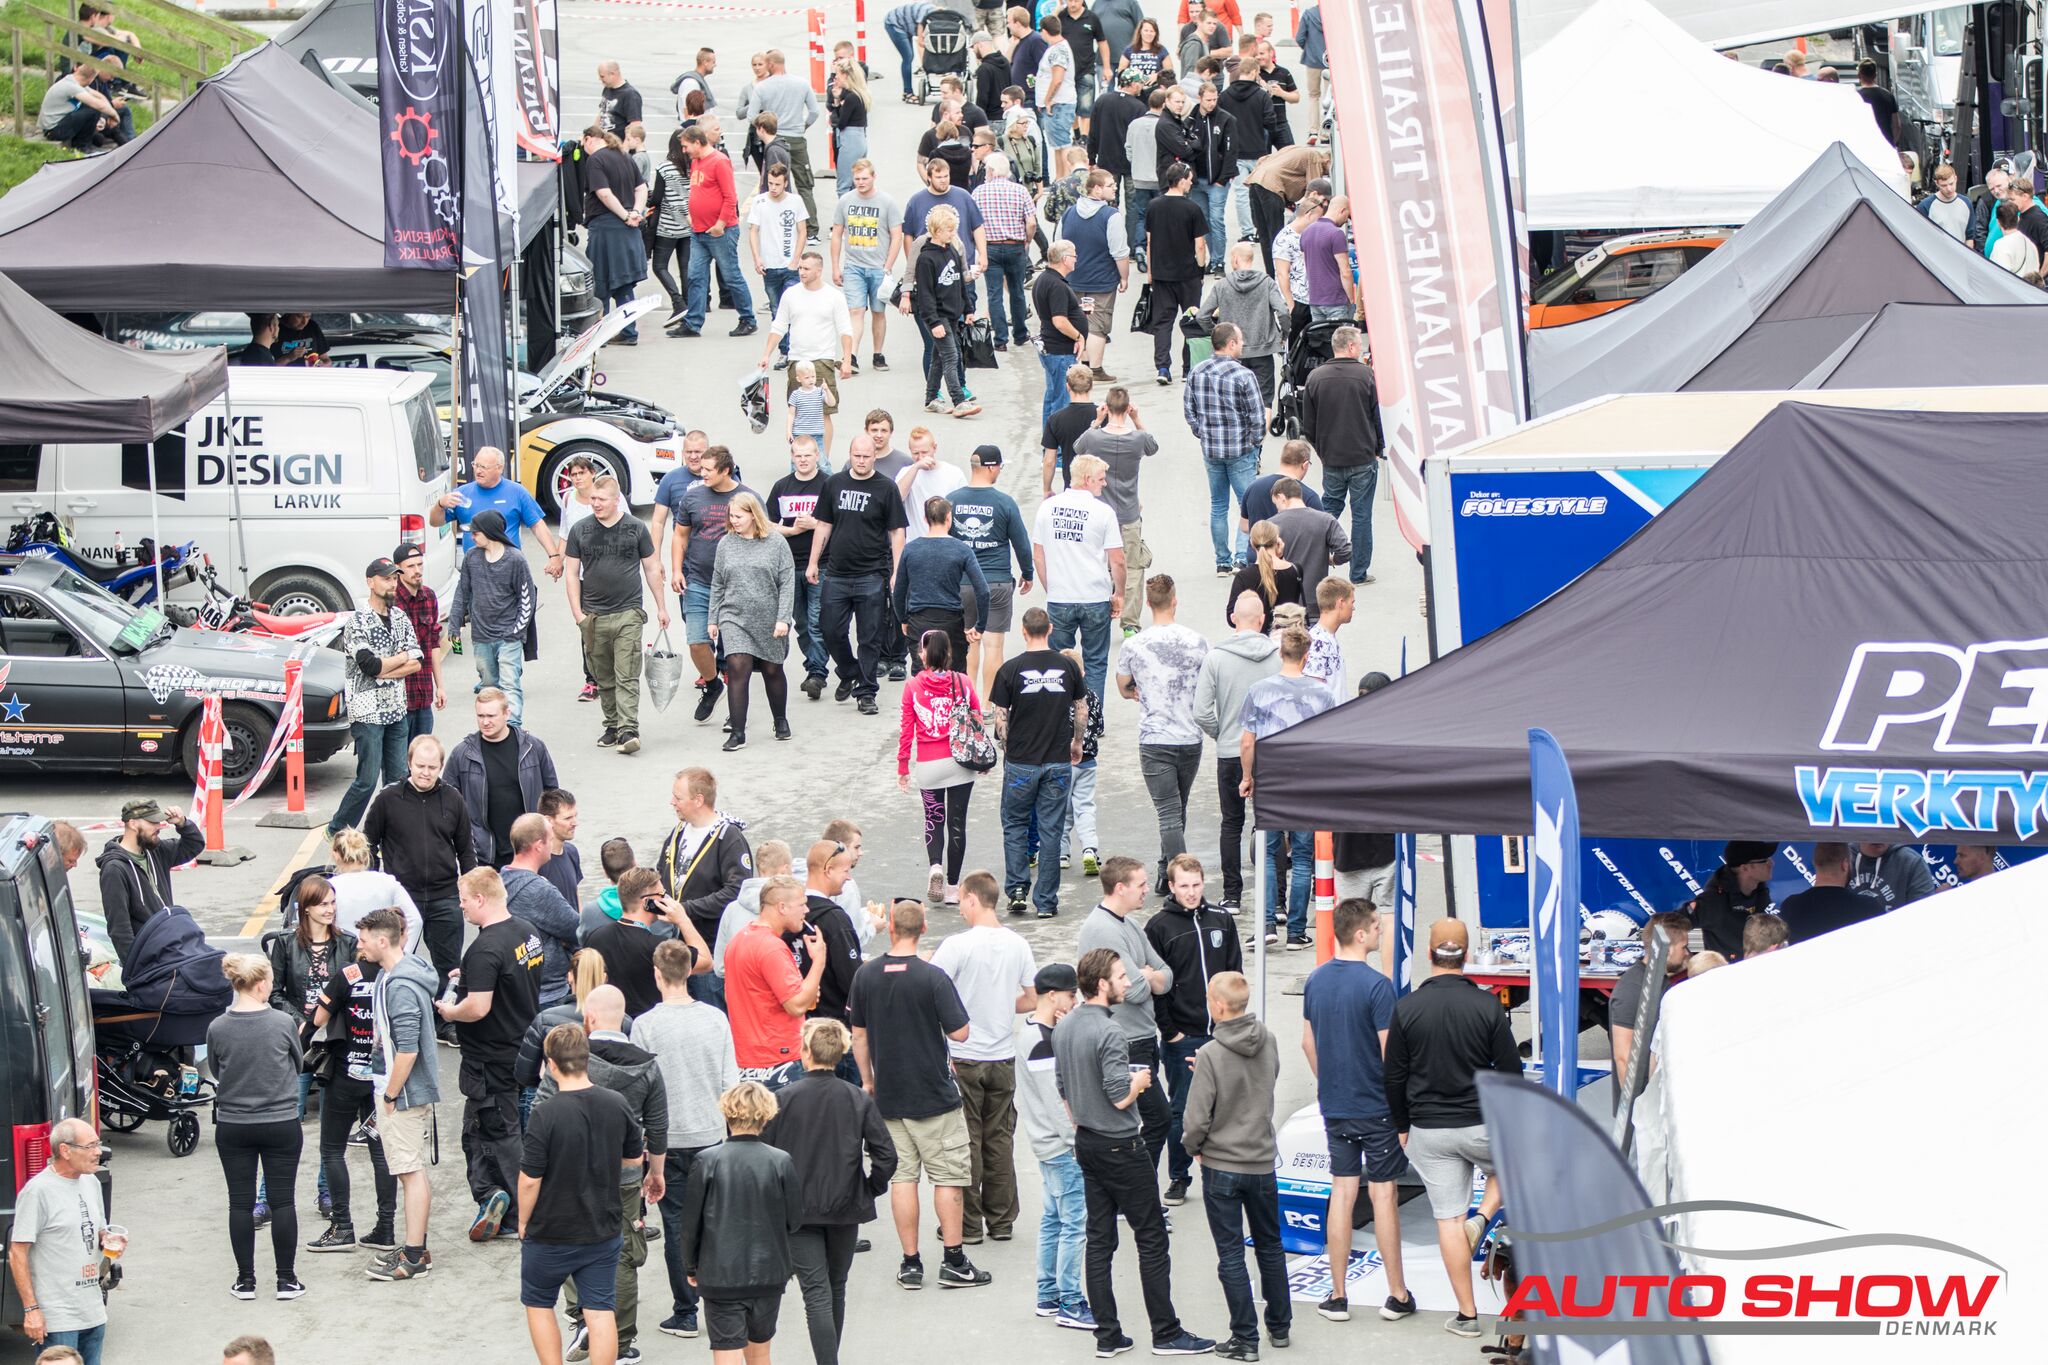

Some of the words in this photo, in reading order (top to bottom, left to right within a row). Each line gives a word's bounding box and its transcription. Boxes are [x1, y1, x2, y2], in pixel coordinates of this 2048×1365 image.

[197, 416, 264, 448] JKE
[197, 454, 342, 486] DESIGN
[274, 494, 342, 509] LARVIK
[838, 489, 872, 512] SNIFF
[1053, 518, 1084, 531] DRIFT
[1055, 531, 1084, 542] TEAM
[1794, 766, 2048, 841] VERKTY
[1592, 847, 1619, 872] NEED
[1613, 871, 1634, 891] FOR
[1283, 1210, 1321, 1230] PC
